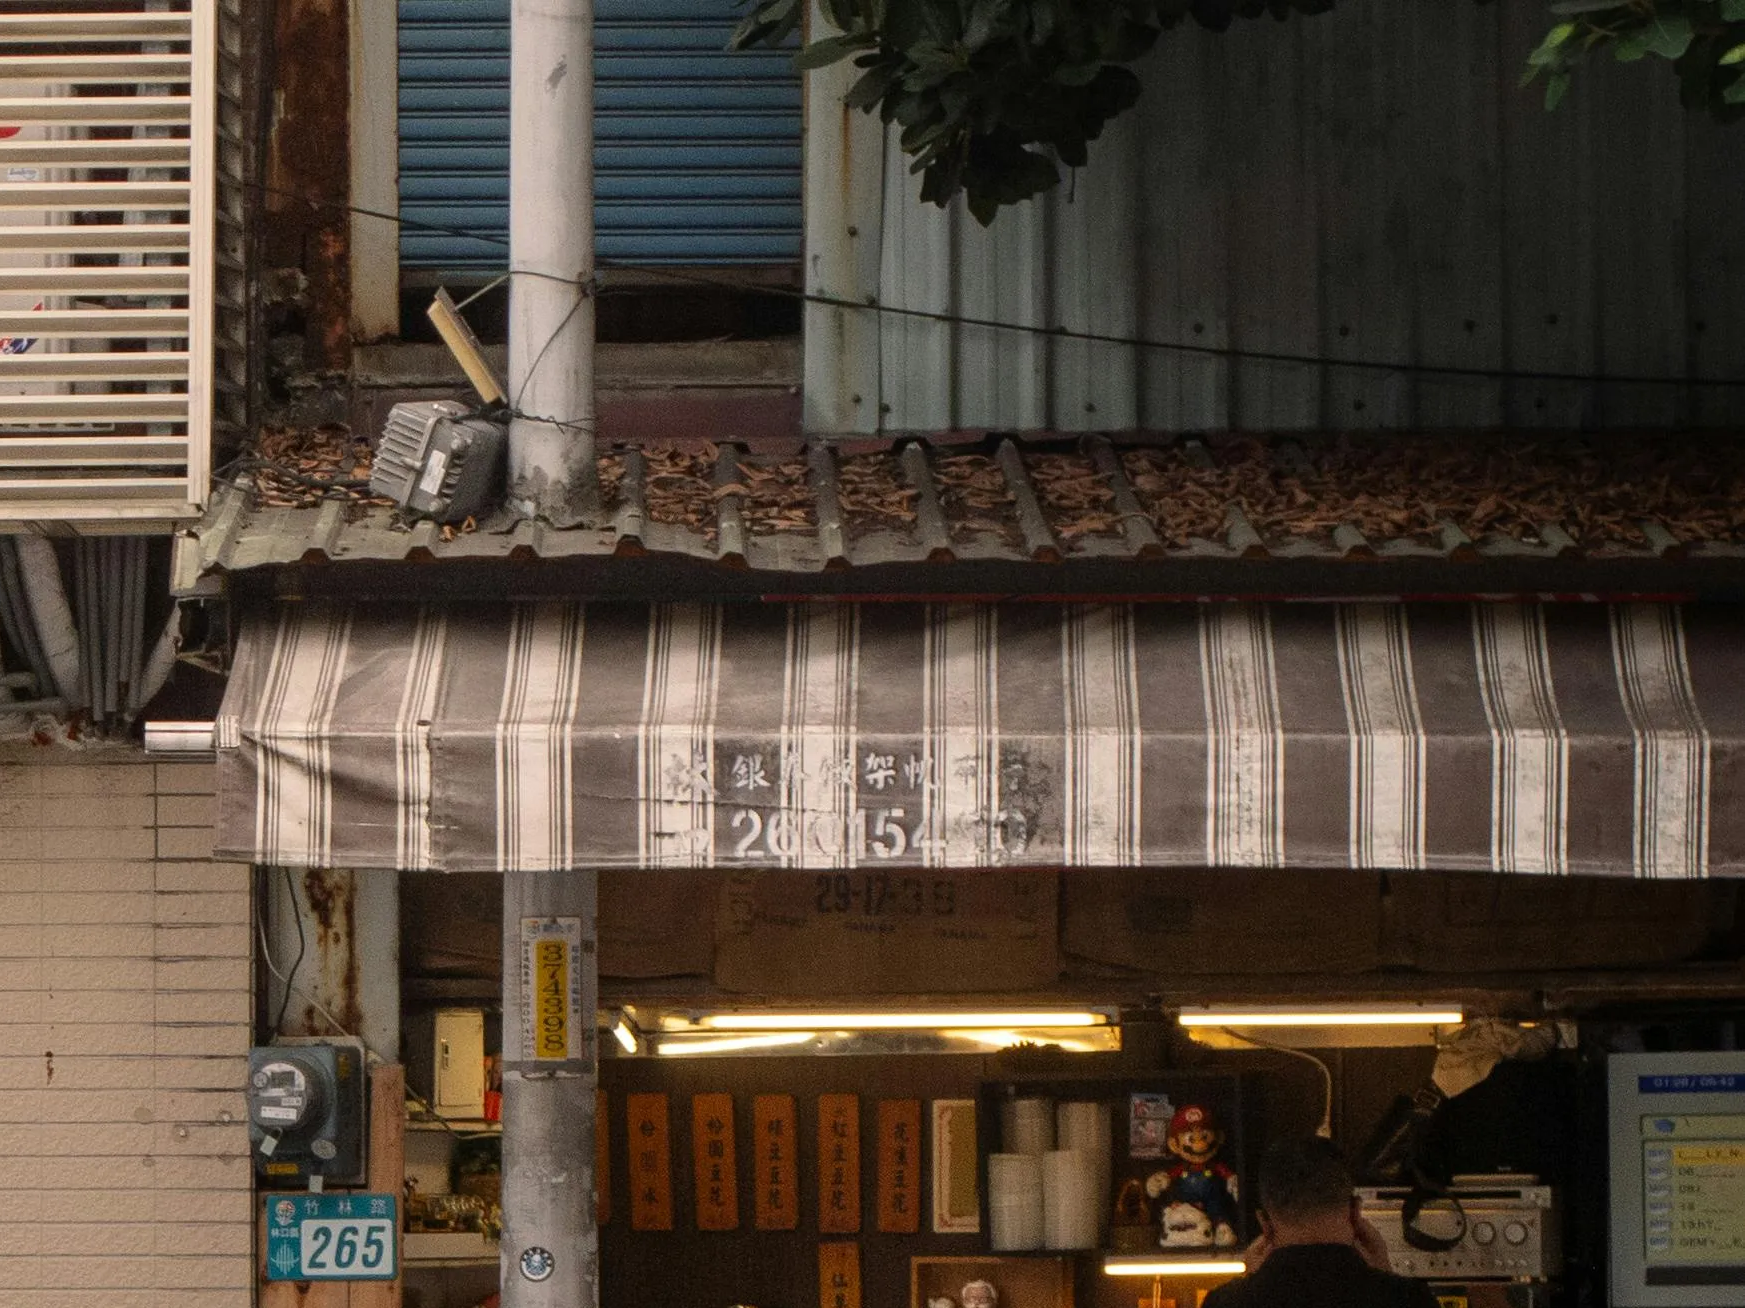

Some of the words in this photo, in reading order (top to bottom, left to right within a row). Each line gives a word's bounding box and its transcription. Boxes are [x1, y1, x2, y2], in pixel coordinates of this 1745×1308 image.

[305, 1199, 387, 1216] 竹林路
[307, 1226, 385, 1270] 265
